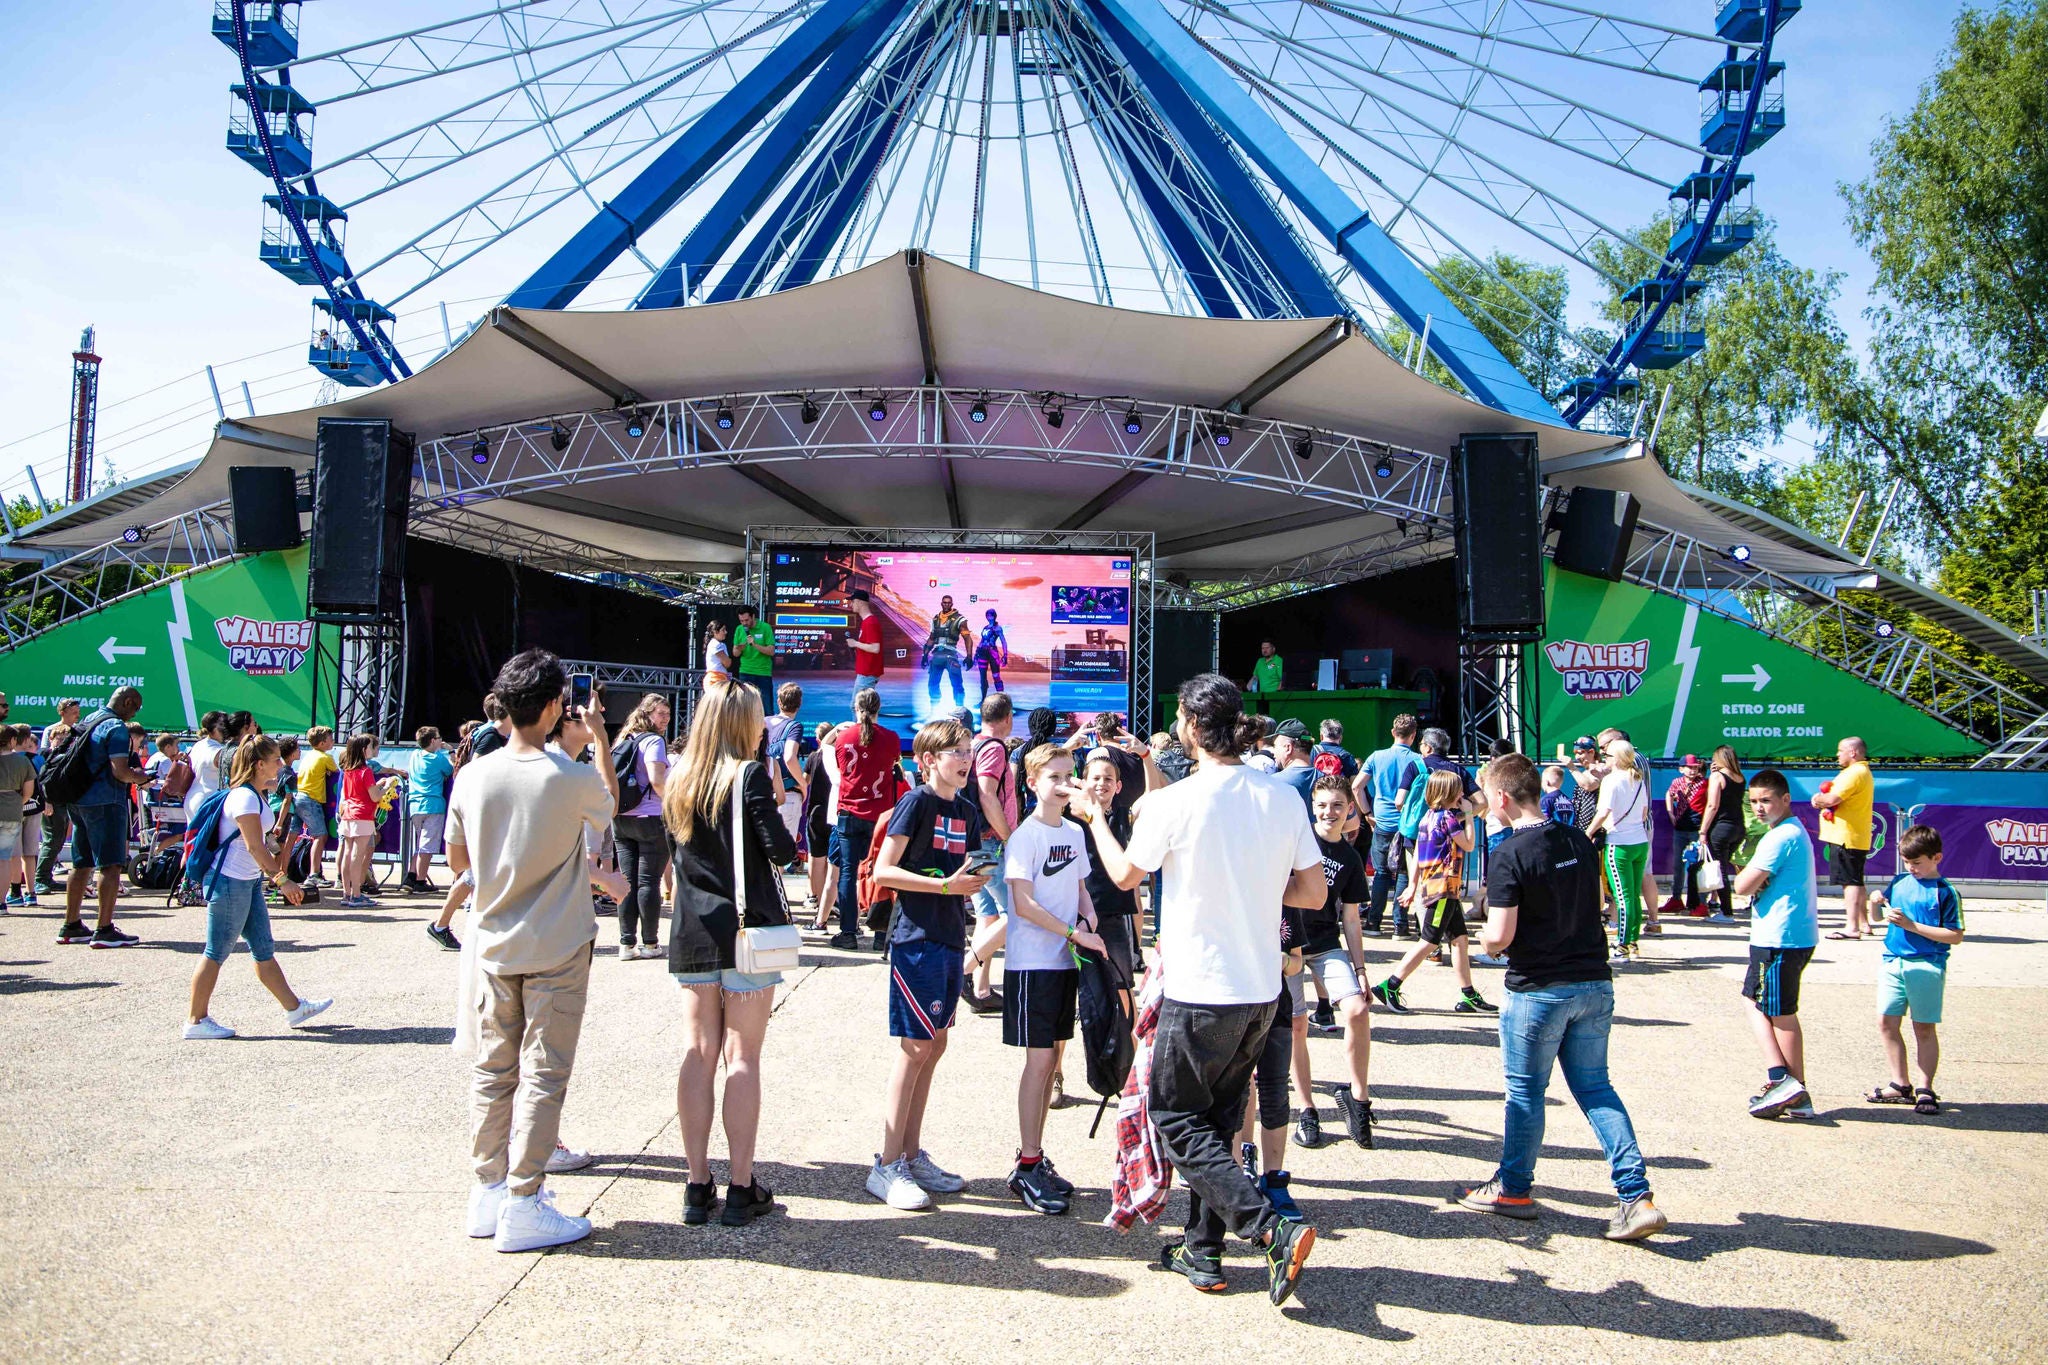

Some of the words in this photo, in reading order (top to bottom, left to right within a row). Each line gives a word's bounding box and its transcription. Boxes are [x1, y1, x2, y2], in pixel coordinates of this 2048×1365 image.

[776, 587, 812, 595] SEASON
[231, 647, 289, 667] PLAY
[109, 676, 145, 687] ZONE
[1565, 671, 1623, 691] PLAY
[1722, 704, 1764, 714] RETRO
[1768, 704, 1805, 714] ZONE
[1723, 727, 1782, 737] CREATOR
[1786, 726, 1823, 737] ZONE
[1048, 845, 1072, 862] NIKE
